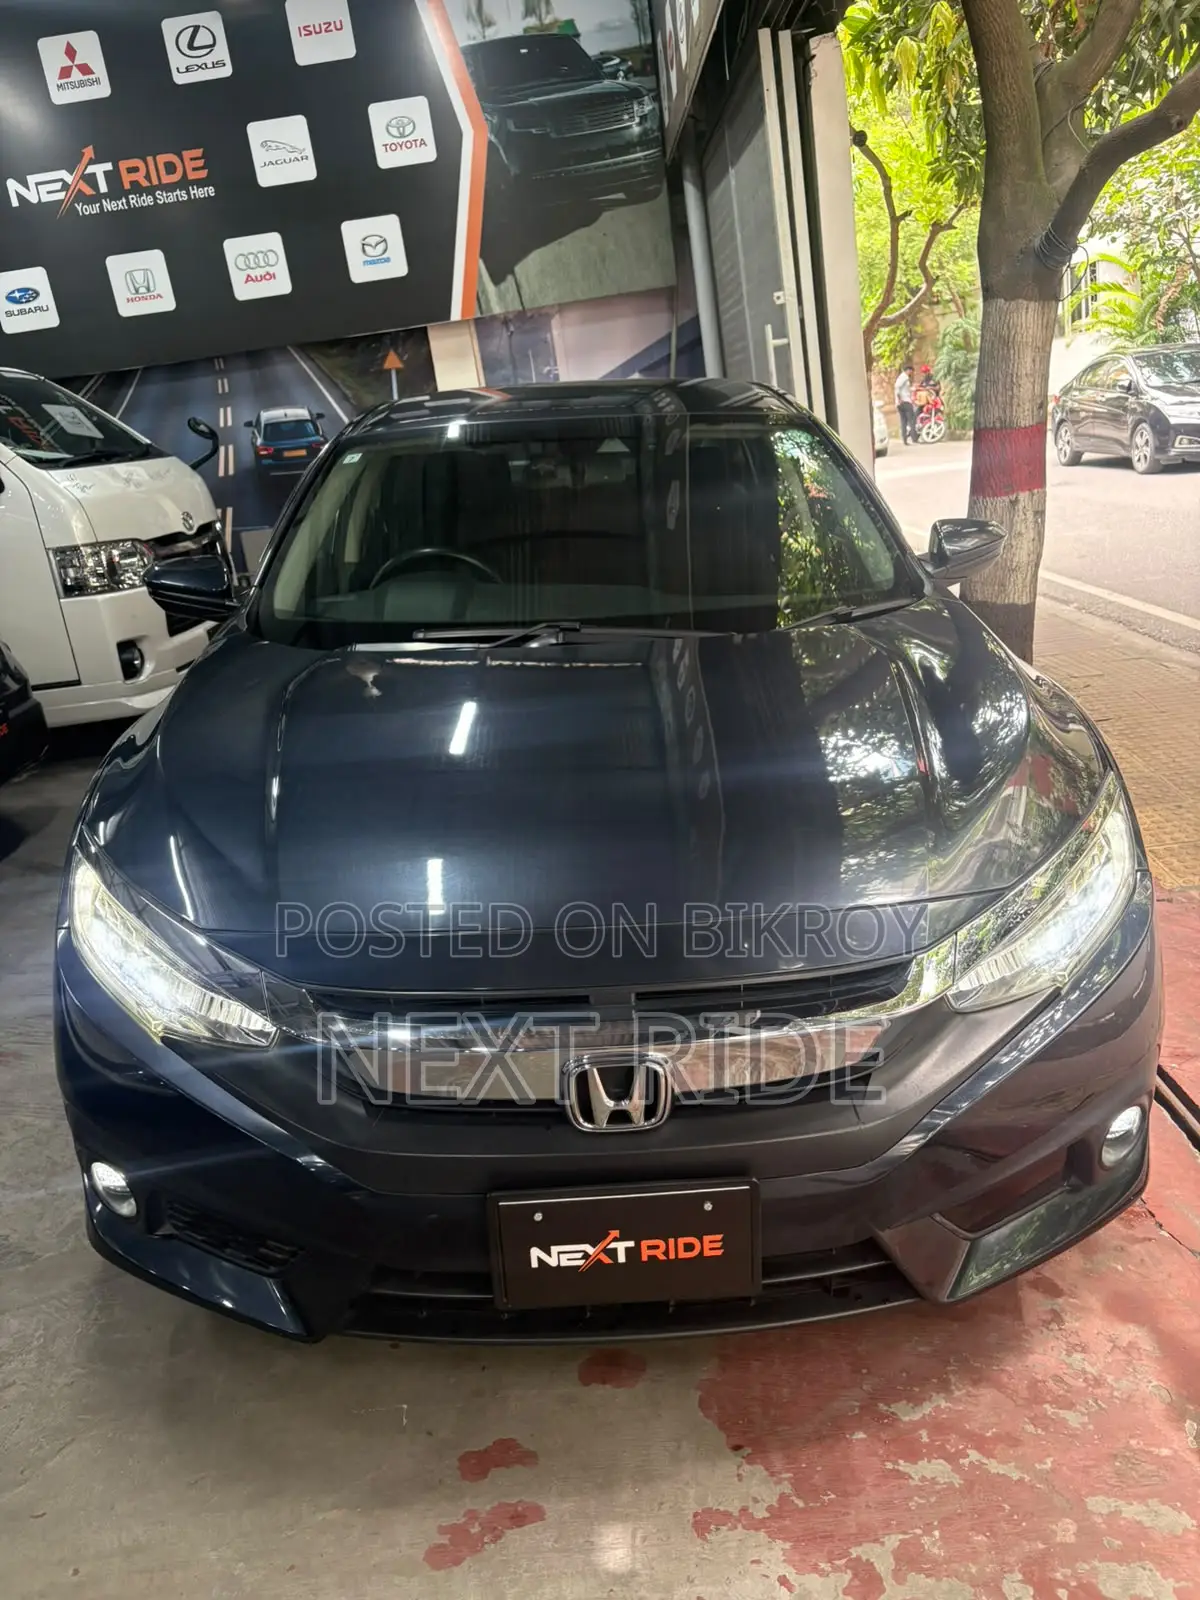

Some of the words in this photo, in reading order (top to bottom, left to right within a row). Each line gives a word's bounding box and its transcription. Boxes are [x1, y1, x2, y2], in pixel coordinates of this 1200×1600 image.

[297, 19, 344, 37] ISUZU
[176, 59, 226, 74] LEXUS
[56, 77, 102, 92] MITSUBISHI
[382, 138, 428, 153] TOYOTA
[260, 155, 310, 168] JAGUAR
[6, 153, 113, 217] NEXT
[118, 148, 208, 189] RIDE
[75, 201, 101, 216] Your
[102, 196, 128, 212] Next
[129, 192, 154, 207] Ride
[156, 189, 188, 204] Starts
[188, 184, 216, 199] Here
[244, 271, 277, 285] Audi
[126, 293, 164, 303] HONDA
[5, 304, 50, 318] SUBARU
[529, 1234, 636, 1271] NEXT
[640, 1233, 725, 1262] RIDE
